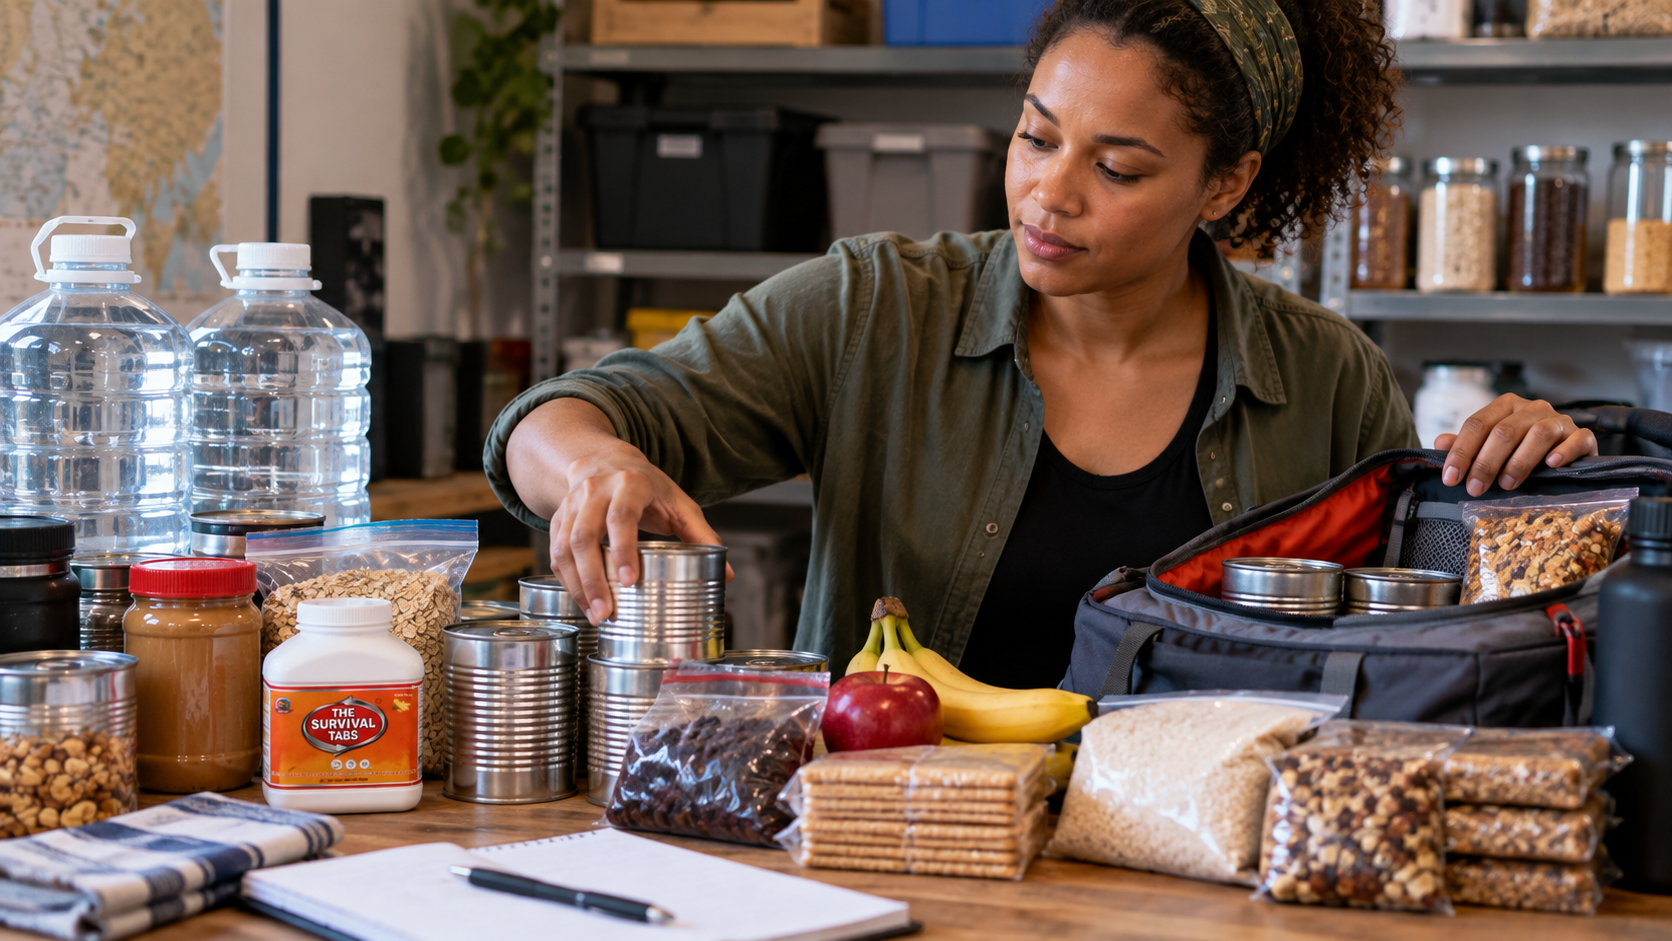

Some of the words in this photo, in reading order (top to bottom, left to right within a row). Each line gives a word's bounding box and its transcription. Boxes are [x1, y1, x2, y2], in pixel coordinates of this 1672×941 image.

[332, 707, 355, 718] THE
[311, 718, 376, 730] SURVIVAL
[328, 730, 359, 741] TABS
